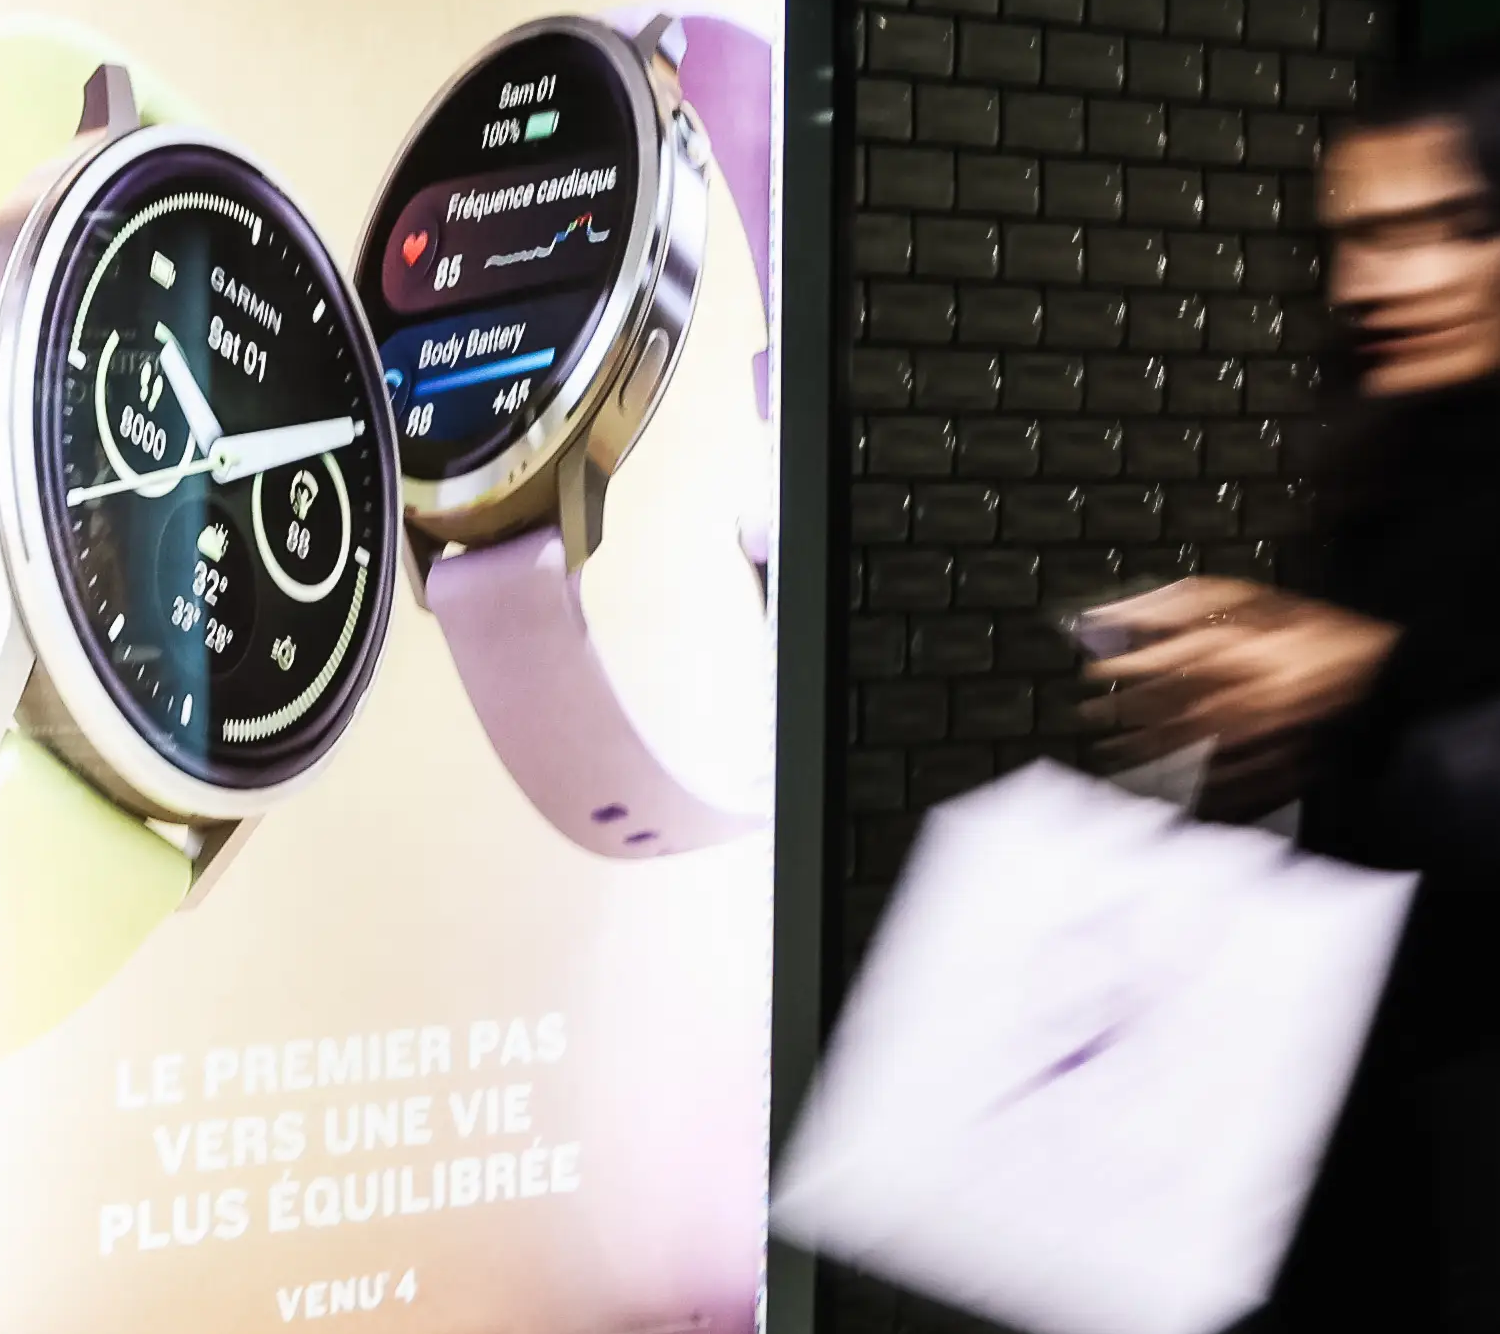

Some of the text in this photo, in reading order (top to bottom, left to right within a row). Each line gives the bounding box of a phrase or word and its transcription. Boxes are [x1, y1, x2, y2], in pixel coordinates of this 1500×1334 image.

[536, 74, 557, 102] 01
[481, 117, 521, 149] 100%
[446, 166, 617, 223] Fréquence cardiaque
[211, 266, 282, 336] GARMIN
[208, 316, 241, 366] Sat
[243, 341, 267, 383] 01
[418, 322, 527, 369] Body Battery
[119, 405, 167, 461] 8000
[114, 1011, 568, 1109] LE PREMIER PAS
[152, 1082, 534, 1176] VERS UNE VIE
[99, 1135, 583, 1257] PLUS ÉQUILIBRÉE
[275, 1265, 420, 1323] VENU 4
